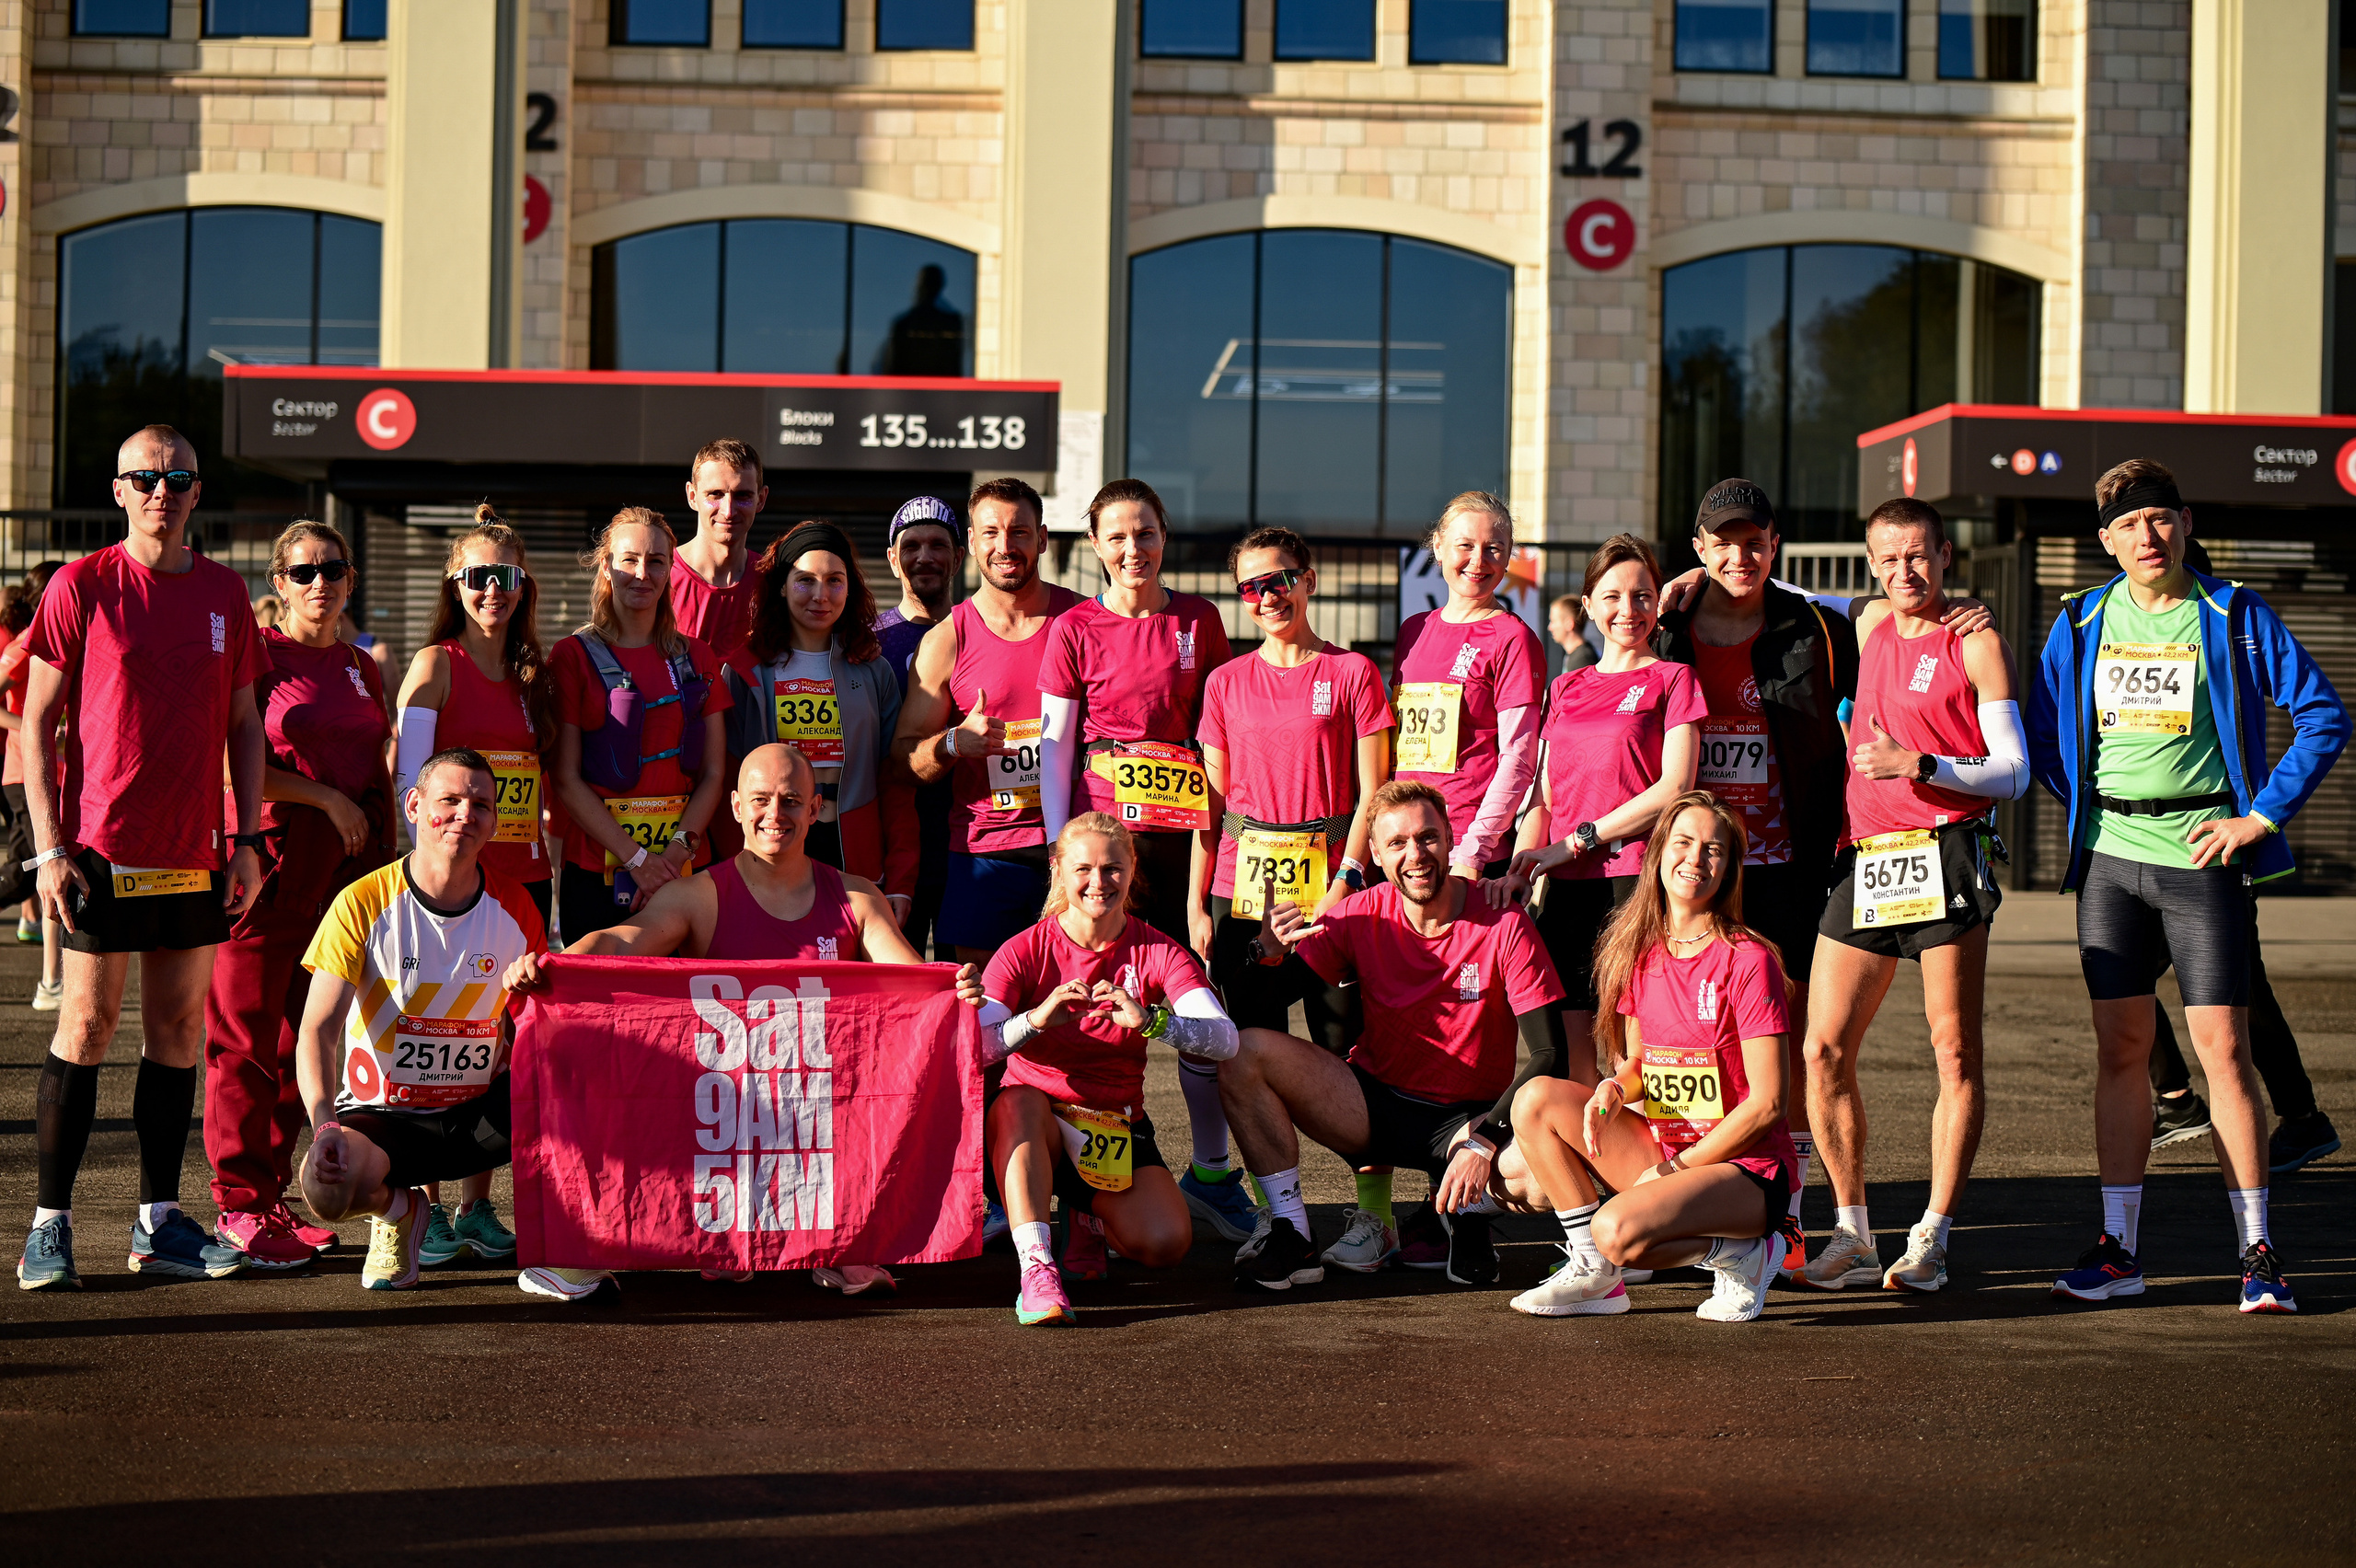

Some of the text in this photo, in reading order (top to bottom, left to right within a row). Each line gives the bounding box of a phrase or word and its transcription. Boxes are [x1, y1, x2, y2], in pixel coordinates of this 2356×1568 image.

[1561, 119, 1642, 178] 12
[272, 398, 339, 421] Сектор
[780, 409, 835, 427] Блоки
[780, 430, 823, 445] Blocks
[860, 414, 1027, 450] 135...138
[2253, 445, 2318, 467] Сектор
[2253, 467, 2299, 483] Sector
[1709, 486, 1745, 502] WILD
[901, 499, 949, 524] СУББОТА
[210, 612, 225, 629] Sat
[211, 627, 225, 642] 9AM
[1175, 630, 1195, 646] Sat
[1178, 644, 1195, 657] 9AM
[1460, 642, 1481, 660] Sat
[1180, 656, 1195, 670] 5KM
[1917, 654, 1938, 671] Sat
[1449, 664, 1469, 679] 5KM
[1913, 668, 1934, 683] 9AM
[1313, 680, 1332, 694] Sat
[1909, 679, 1930, 694] 5KM
[2108, 666, 2181, 695] 9654
[802, 686, 830, 694] МОСКВА
[1312, 692, 1332, 705] 9AM
[2120, 696, 2162, 705] ДМИТРИЙ
[1311, 703, 1331, 716] 5KM
[797, 727, 842, 735] АЛЕКСАНД
[1011, 728, 1041, 738] МОСКВА
[1736, 724, 1744, 732] 10
[1746, 724, 1760, 732] КМ
[1404, 737, 1426, 745] ЕЛЕНА
[1141, 744, 1177, 754] МАРАФОН
[1141, 749, 1172, 759] МОСКВА
[1178, 753, 1186, 761] 10
[1118, 763, 1205, 797] 33578
[1702, 770, 1738, 779] МИХАИЛ
[999, 792, 1011, 806] D
[1145, 791, 1180, 803] МАРИНА
[1126, 805, 1138, 819] D
[1246, 855, 1311, 884] 7831
[1864, 855, 1929, 890] 5675
[123, 875, 136, 892] D
[1872, 886, 1921, 900] КОНСТАНТИН
[1242, 899, 1253, 915] D
[816, 936, 838, 953] Sat
[401, 956, 421, 971] GRi
[1460, 963, 1480, 976] Sat
[1460, 976, 1480, 988] 9AM
[1460, 988, 1480, 1000] 5KM
[1697, 1007, 1717, 1020] 5KM
[426, 1020, 466, 1029] МАРАФОН
[689, 975, 832, 1071] Sat
[425, 1027, 458, 1035] МОСКВА
[476, 1028, 491, 1036] КМ
[395, 1041, 491, 1071] 25163
[1652, 1050, 1682, 1058] МАРАФОН
[419, 1072, 464, 1082] ДМИТРИЙ
[695, 1071, 833, 1151] 9AM
[1659, 1105, 1690, 1115] АДИЛЯ
[693, 1152, 834, 1233] 5KM
